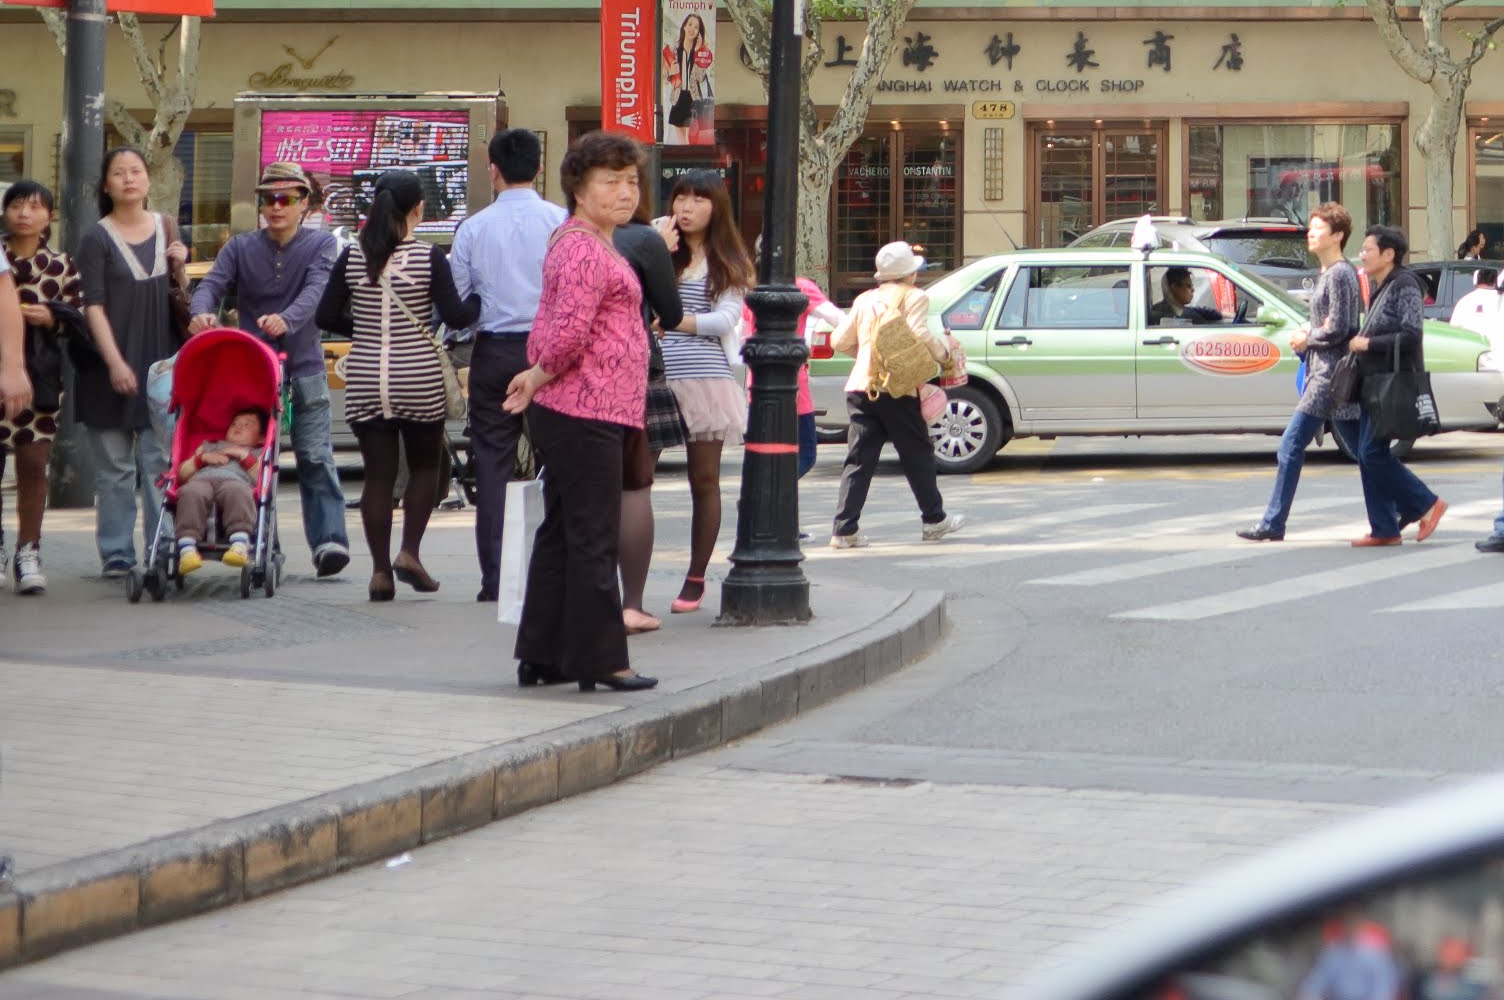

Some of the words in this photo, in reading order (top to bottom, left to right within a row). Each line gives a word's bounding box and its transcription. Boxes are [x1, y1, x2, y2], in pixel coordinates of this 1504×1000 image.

[669, 0, 706, 12] Triumph
[615, 7, 641, 107] Triumph
[944, 79, 1002, 93] WATCH
[1013, 79, 1024, 93] &
[1036, 79, 1090, 93] CLOCK
[1100, 79, 1145, 93] SHOP
[979, 103, 1008, 113] 478
[1195, 342, 1270, 357] 62580000
